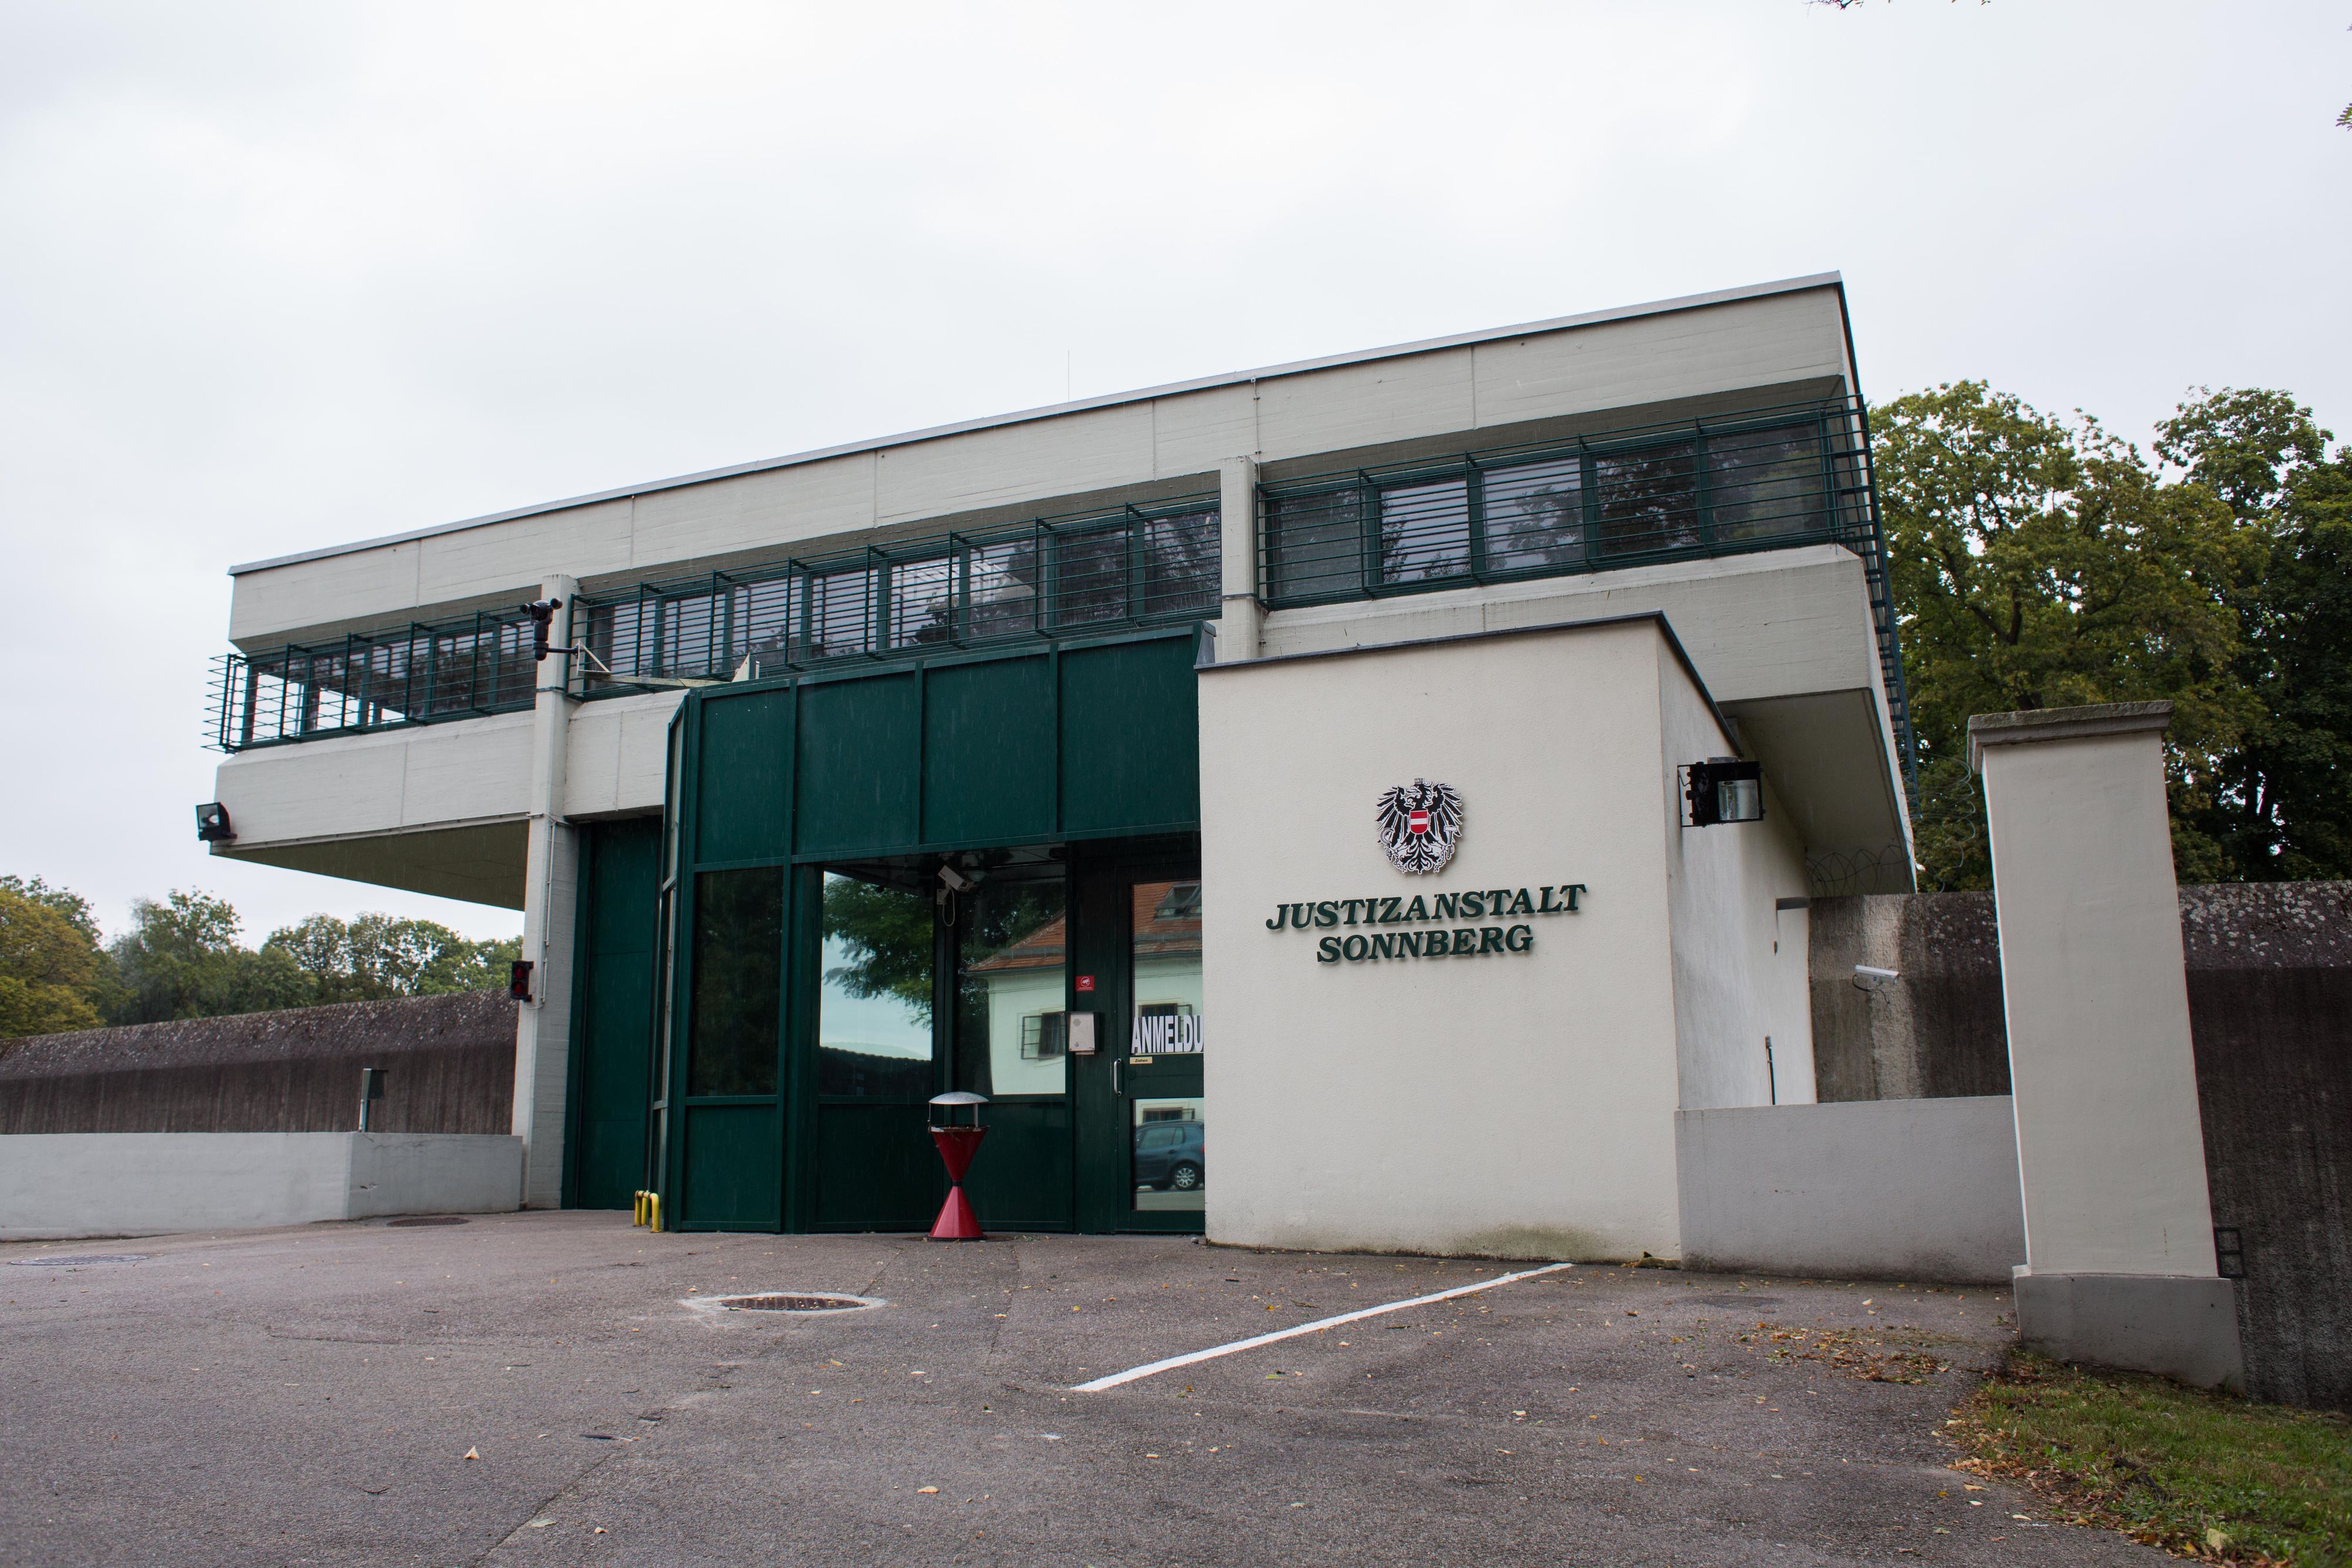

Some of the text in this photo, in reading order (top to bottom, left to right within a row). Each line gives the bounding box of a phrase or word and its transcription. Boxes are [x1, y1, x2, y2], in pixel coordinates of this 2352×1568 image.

[1265, 884, 1586, 930] JUSTIZANSTALT
[1316, 924, 1534, 962] SONNBERG
[1131, 1015, 1204, 1054] ANMELDU
